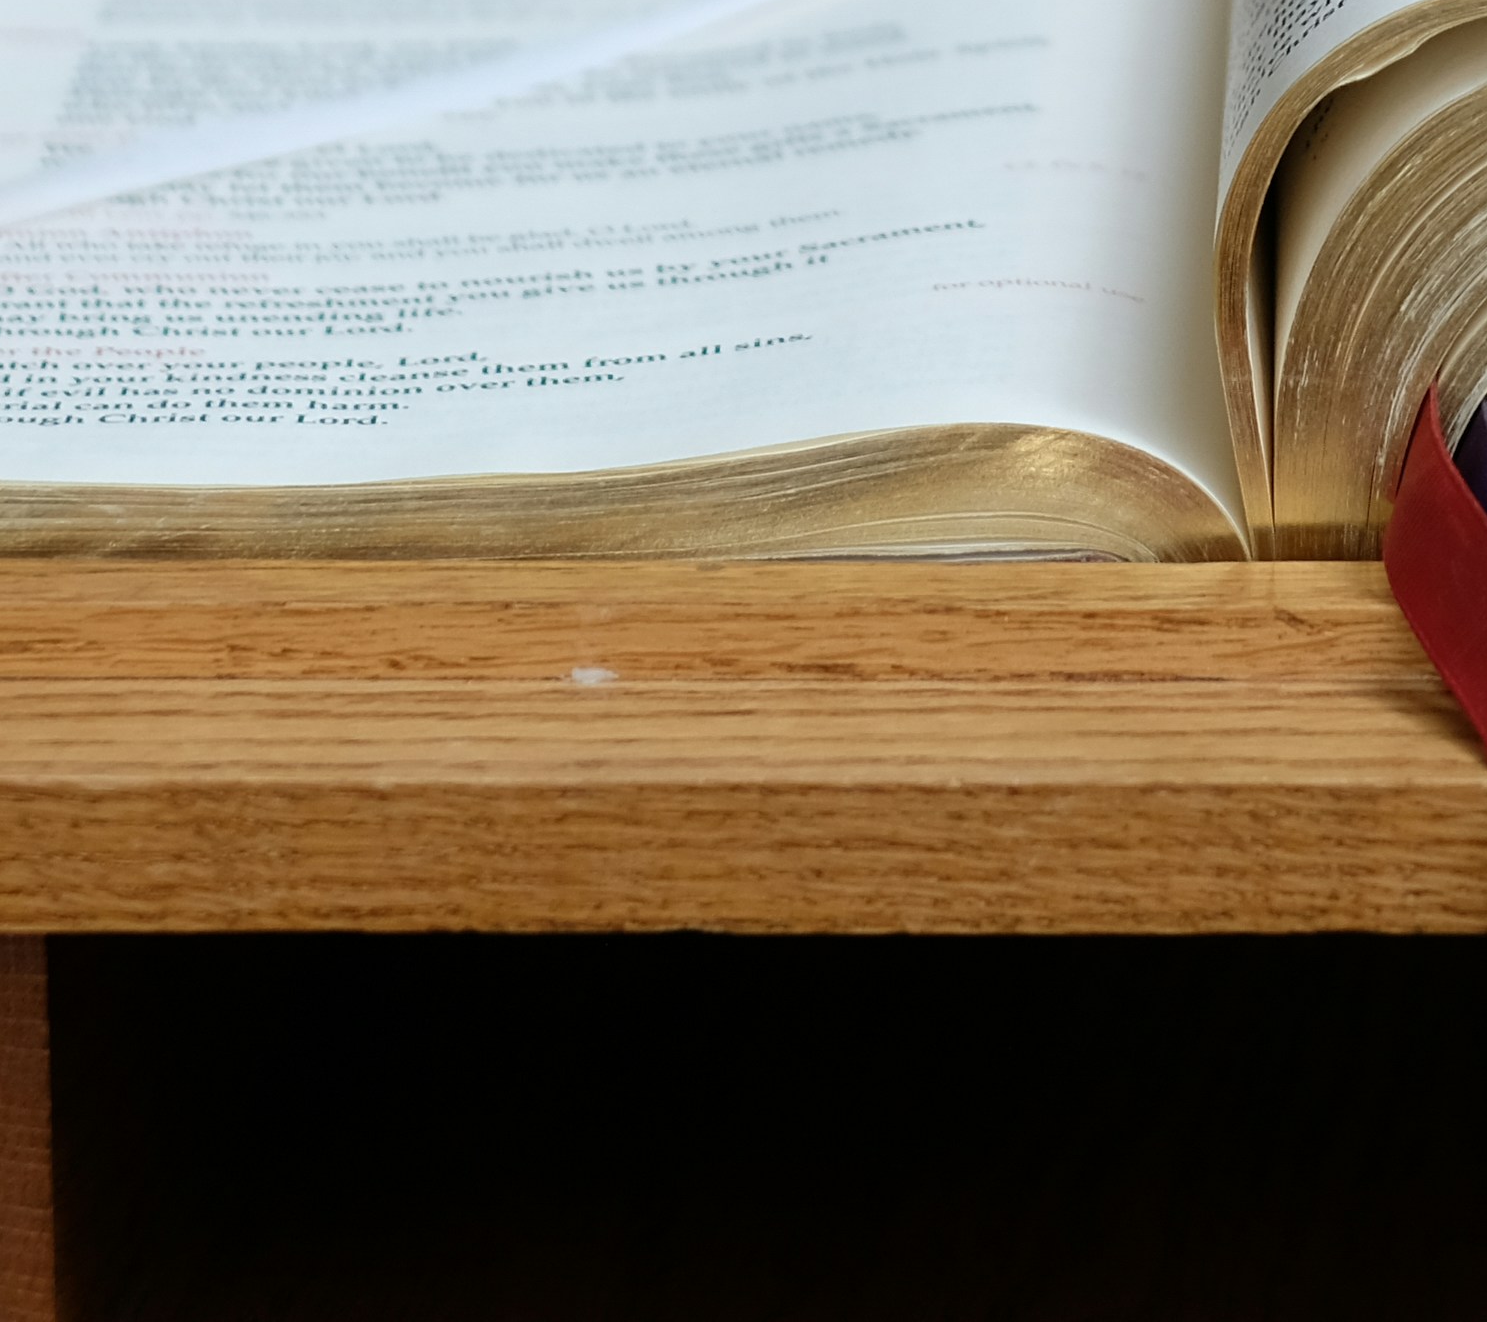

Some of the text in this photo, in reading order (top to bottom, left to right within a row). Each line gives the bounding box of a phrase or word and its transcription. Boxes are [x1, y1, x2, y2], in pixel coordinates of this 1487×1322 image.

[121, 283, 198, 296] who
[209, 286, 302, 296] never
[315, 284, 405, 296] cease
[417, 280, 450, 291] to
[461, 268, 593, 288] nourish
[606, 268, 644, 278] us
[655, 262, 698, 275] by
[709, 249, 789, 272] your
[797, 217, 985, 254] Sacrament,
[79, 298, 145, 311] that
[158, 298, 211, 311] the
[223, 292, 435, 310] refreshment
[447, 290, 511, 306] you
[519, 280, 594, 300] give
[606, 280, 644, 292] us
[655, 259, 793, 287] through
[806, 253, 829, 267] it
[932, 280, 971, 292] for
[978, 277, 1092, 292] optional
[60, 311, 152, 325] bring
[164, 314, 203, 324] us
[215, 310, 384, 324] unending
[396, 307, 463, 319] life.
[132, 324, 241, 338] Christ
[250, 327, 314, 337] our
[323, 321, 412, 337] Lord.
[31, 345, 84, 358] the
[95, 344, 206, 359] People
[23, 373, 58, 384] in
[68, 375, 154, 386] your
[163, 372, 328, 383] kindness
[339, 368, 469, 383] cleanse
[481, 363, 569, 376] them
[584, 355, 667, 369] from
[678, 343, 722, 359] all
[72, 361, 151, 371] over
[159, 361, 244, 373] your
[254, 358, 384, 372] people,
[398, 350, 488, 368] Lord,
[4, 386, 33, 398] if
[40, 387, 106, 398] evil
[120, 386, 179, 397] has
[192, 387, 236, 397] no
[246, 384, 422, 397] dominion
[436, 379, 515, 392] over
[525, 373, 626, 388] them,
[74, 401, 134, 411] can
[146, 399, 192, 411] do
[204, 397, 293, 410] them
[309, 399, 410, 411] harm.
[97, 412, 210, 424] Christ
[220, 414, 285, 424] our
[295, 413, 389, 426] Lord.
